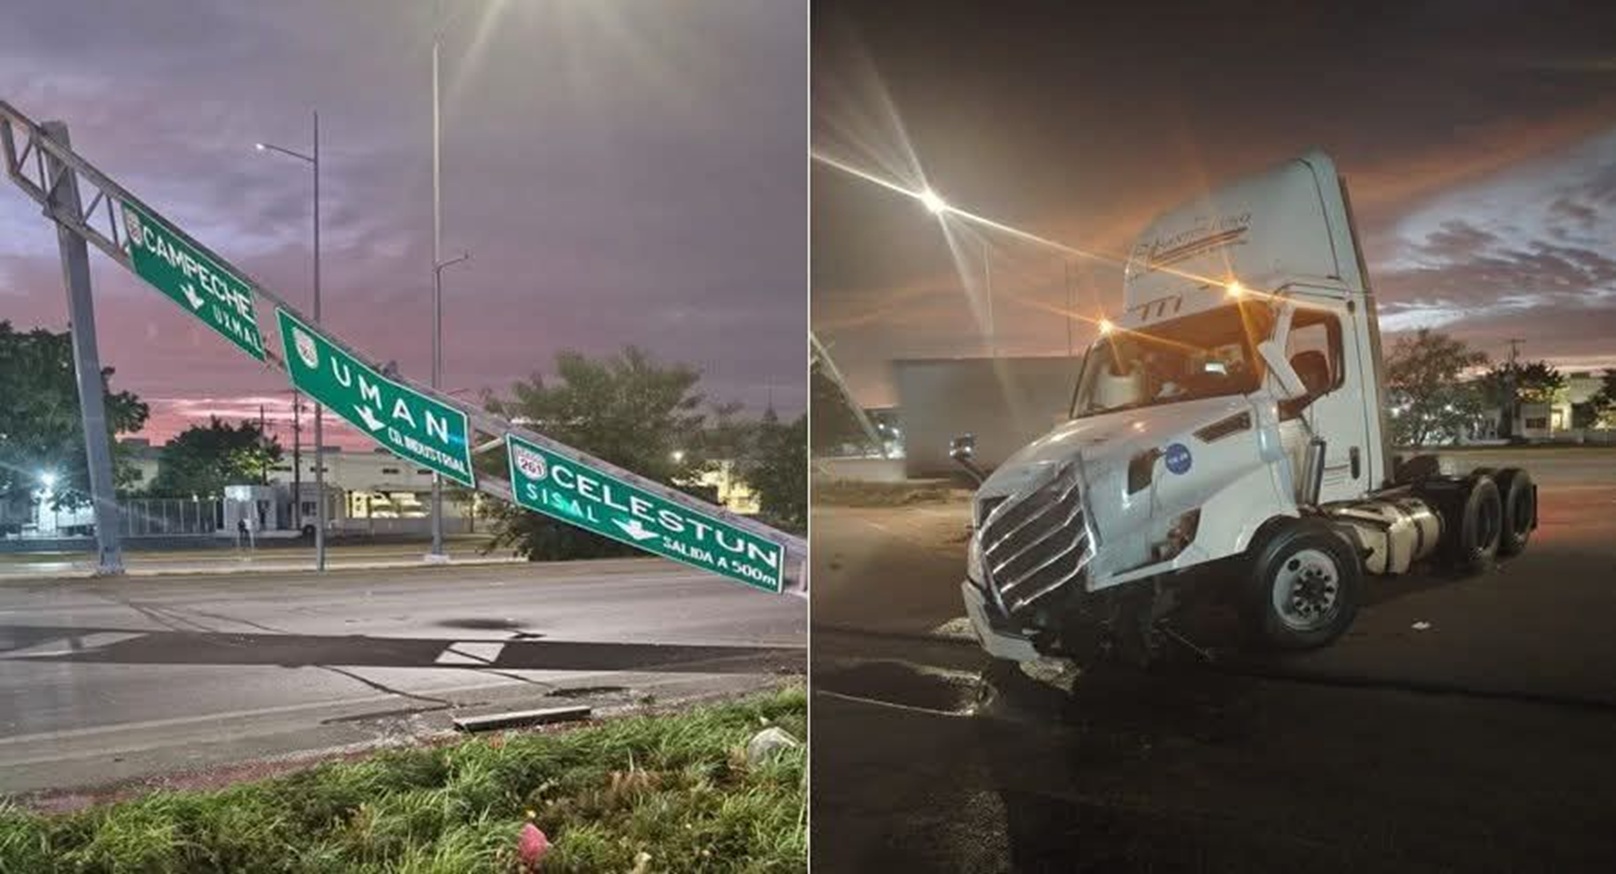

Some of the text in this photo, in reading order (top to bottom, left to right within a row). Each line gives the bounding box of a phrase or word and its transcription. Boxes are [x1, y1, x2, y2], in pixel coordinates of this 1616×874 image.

[143, 226, 257, 324] CAMPECHE
[331, 356, 449, 444] UMAN
[526, 482, 600, 523] SISAL
[551, 465, 777, 568] CELESTUN
[663, 535, 777, 587] SALIDA A 500m
